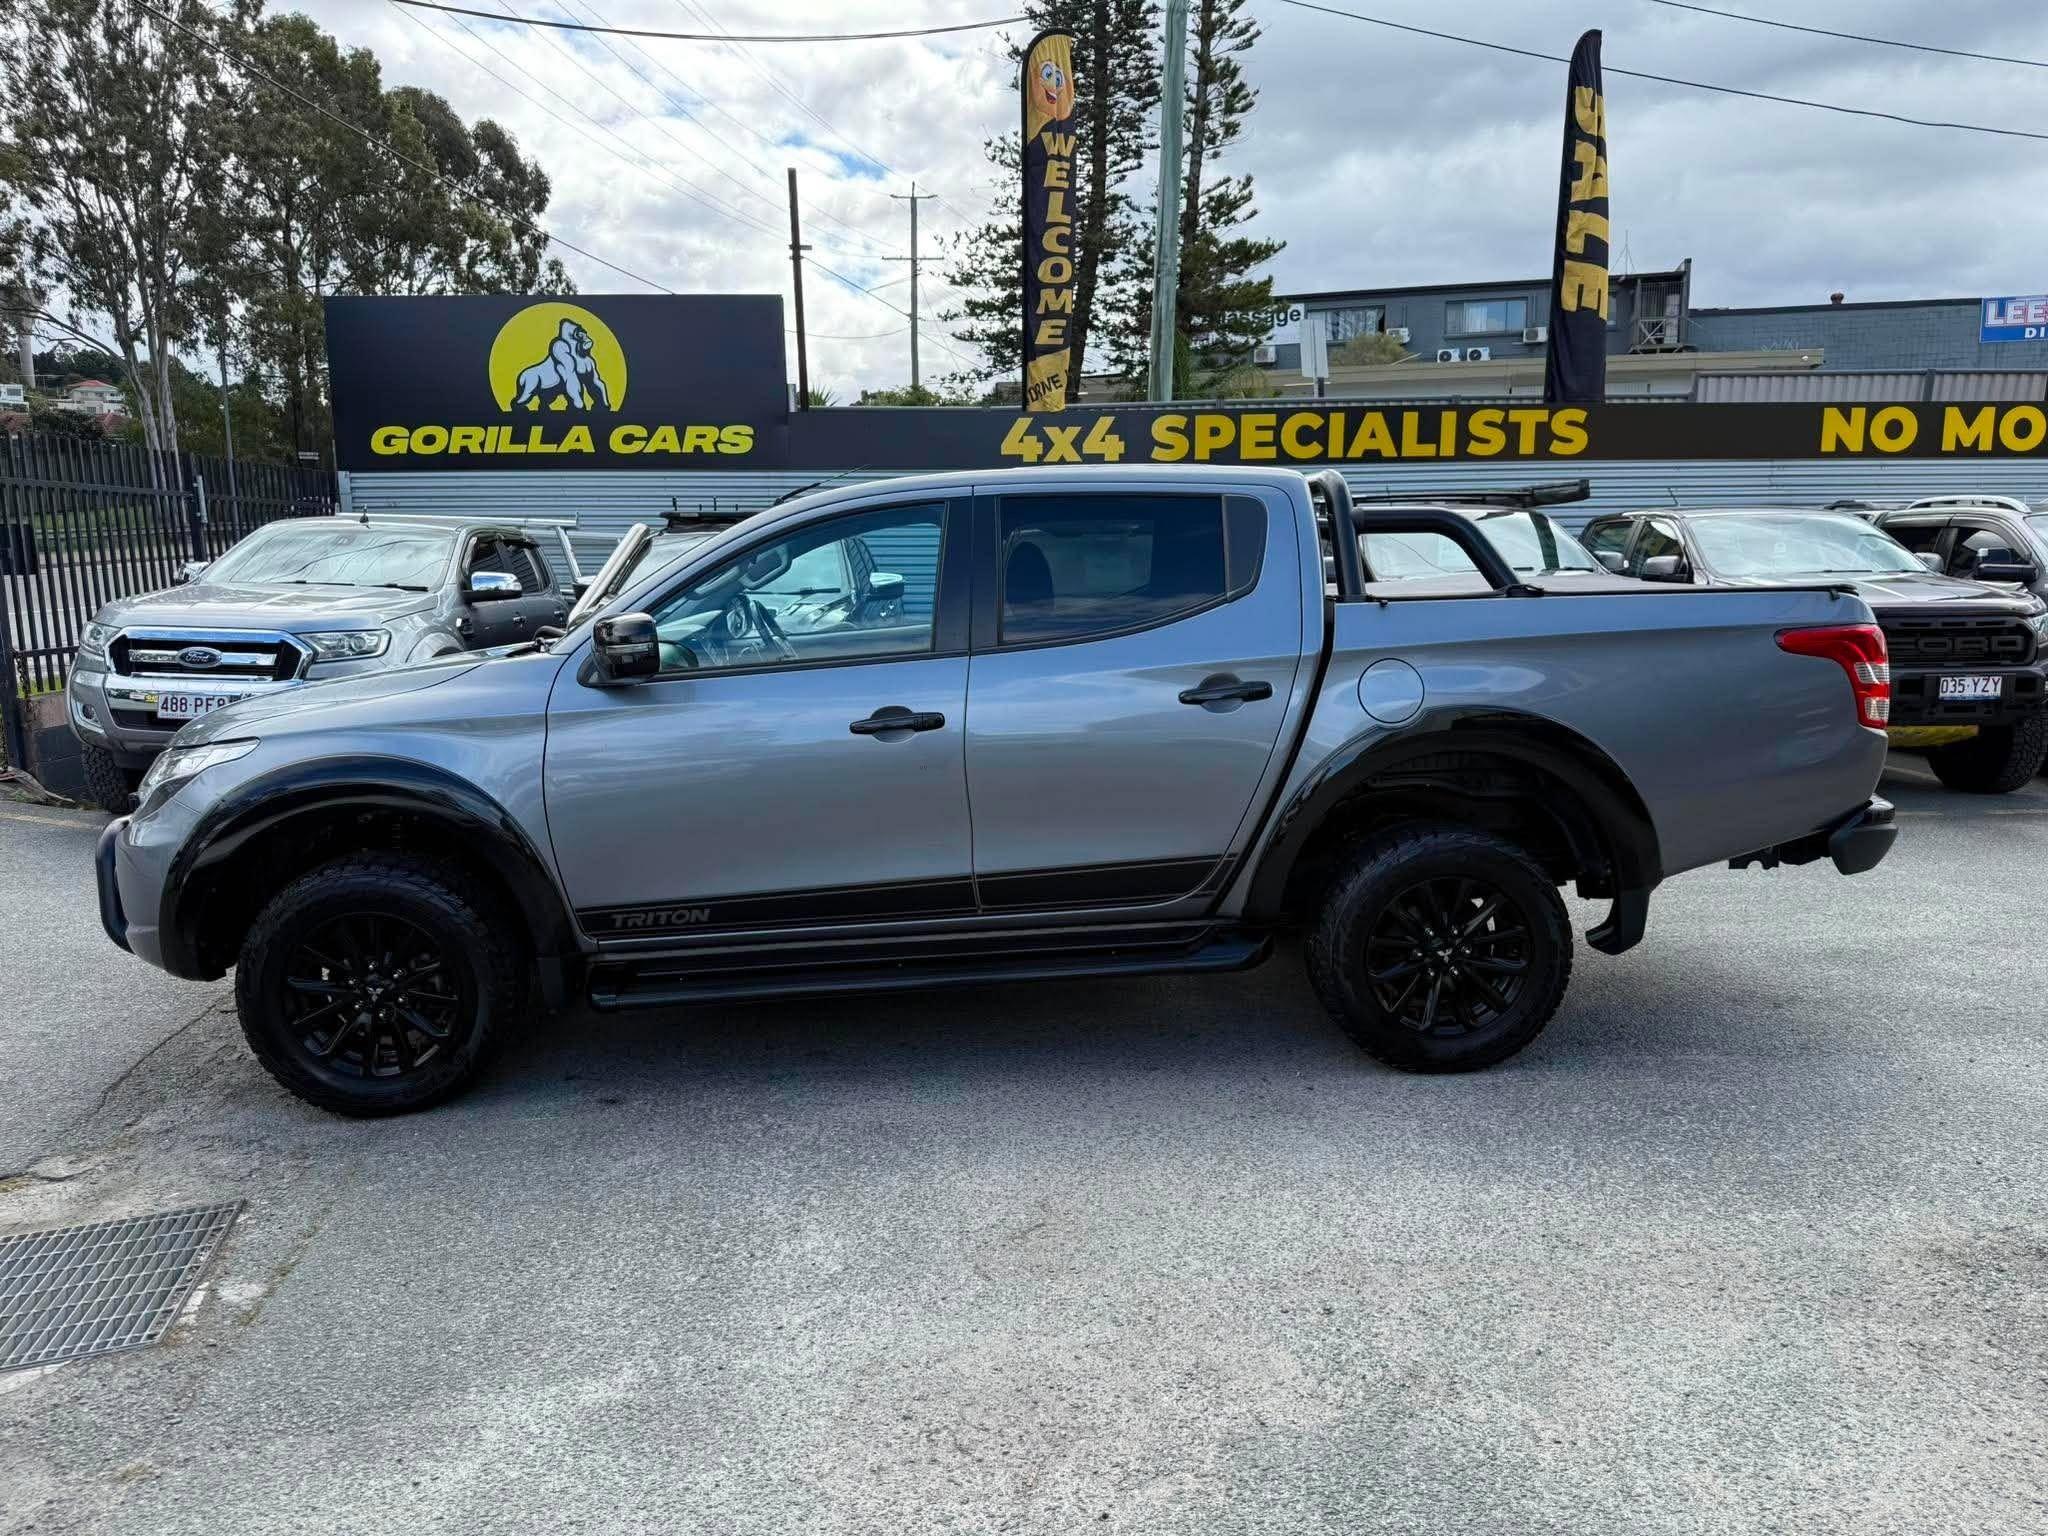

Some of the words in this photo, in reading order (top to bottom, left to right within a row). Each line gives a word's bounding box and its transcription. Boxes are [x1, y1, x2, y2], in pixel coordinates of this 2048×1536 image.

[1561, 85, 1609, 321] SALE
[1034, 131, 1076, 345] WELCOME
[1028, 373, 1063, 402] DRIVE
[371, 426, 595, 454] GORILLA
[609, 425, 754, 454] CARS
[1000, 416, 1125, 463] 4x4
[1150, 408, 1589, 462] SPECIALISTS
[1820, 406, 1919, 452] NO
[1941, 406, 2047, 452] MO
[185, 651, 209, 663] Ford
[611, 908, 711, 928] TRITON
